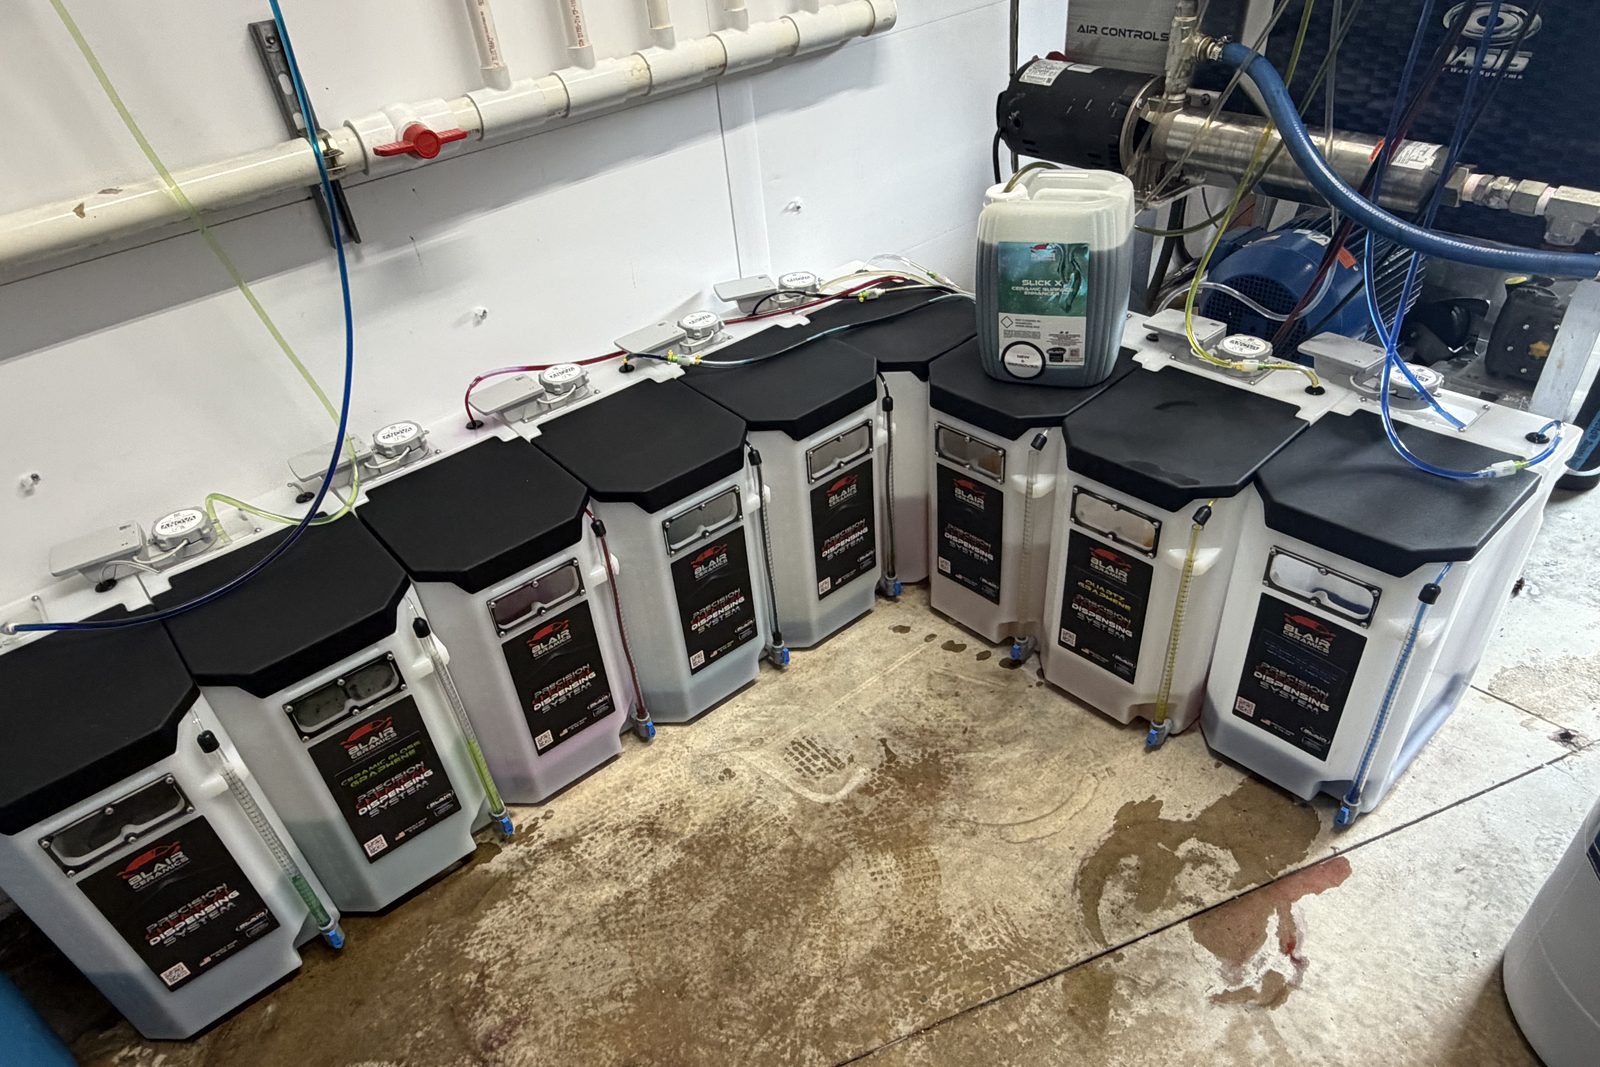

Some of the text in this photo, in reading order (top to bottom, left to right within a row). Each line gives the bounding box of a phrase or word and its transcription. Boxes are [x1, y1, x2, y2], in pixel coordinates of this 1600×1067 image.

[1077, 24, 1170, 42] AIR CONTROLS
[828, 483, 856, 504] BLAIR
[954, 486, 984, 506] BLAIR
[821, 525, 868, 558] DISPENSING
[826, 534, 864, 561] SYSTEM
[944, 531, 993, 561] DISPENSING
[694, 553, 727, 575] BLAIR
[1090, 556, 1127, 579] BLAIR
[693, 587, 741, 618] PRECISION
[1077, 580, 1131, 612] GRAPHENE
[1084, 578, 1126, 602] QUARTZ
[691, 595, 745, 631] DISPENSING
[698, 604, 741, 633] SYSTEM
[1071, 601, 1132, 638] DISPENSING
[1076, 611, 1124, 640] SYSTEM
[530, 629, 570, 654] BLAIR
[1281, 628, 1329, 653] CERAMICS
[1283, 622, 1330, 649] BLAIR
[532, 670, 596, 711] DISPENSING
[533, 663, 590, 698] PRECISION
[1253, 669, 1330, 712] DISPENSING
[1260, 660, 1330, 699] PRECISION
[540, 680, 592, 714] SYSTEM
[1259, 679, 1320, 715] SYSTEM
[347, 726, 394, 756] BLAIR
[349, 732, 397, 760] CERAMICS
[348, 747, 417, 789] GRAPHENE
[356, 760, 425, 803] PRECISION
[357, 768, 433, 816] DISPENSING
[368, 778, 429, 818] SYSTEM
[126, 849, 185, 886] BLAIR
[130, 855, 188, 889] CERAMICS
[144, 881, 229, 933] PRECISION
[147, 888, 240, 946] DISPENSING
[161, 899, 236, 946] SYSTEM
